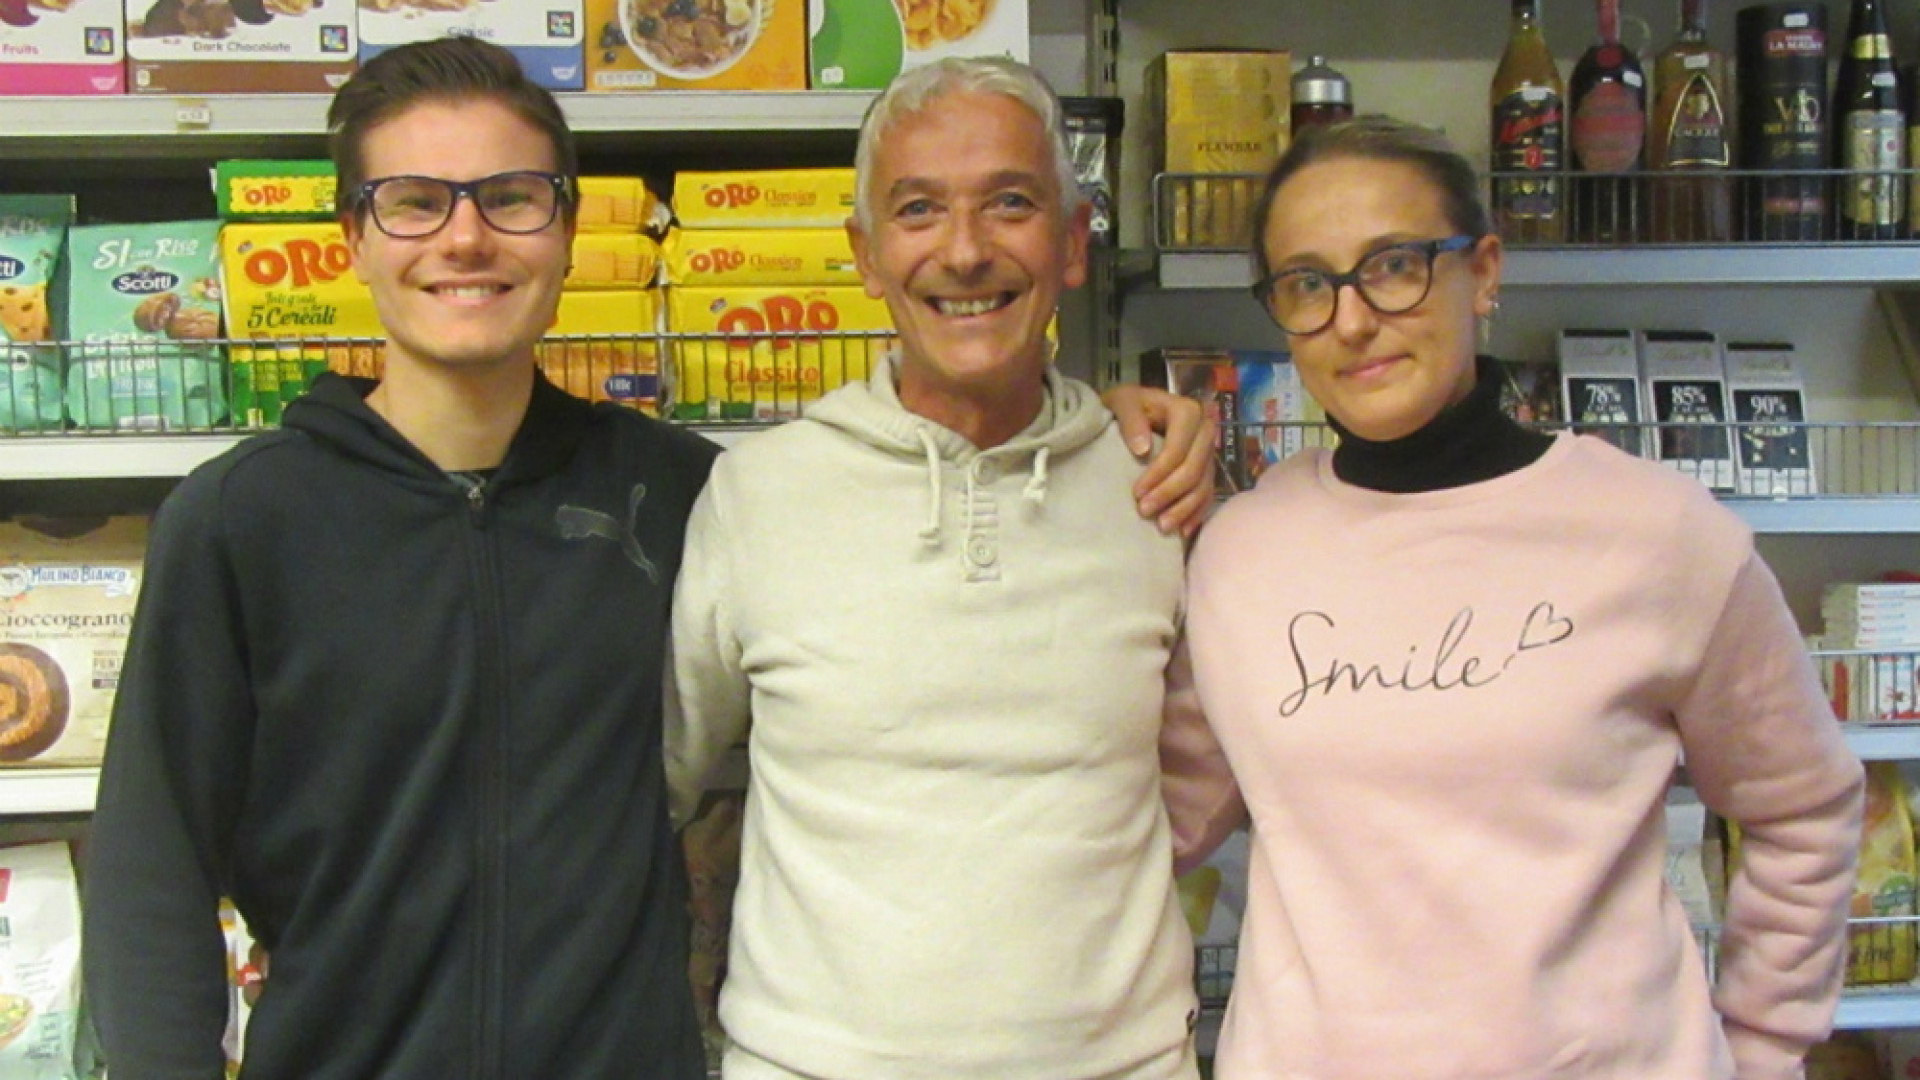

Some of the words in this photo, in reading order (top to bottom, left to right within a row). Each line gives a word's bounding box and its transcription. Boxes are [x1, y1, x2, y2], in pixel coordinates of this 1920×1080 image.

[446, 25, 495, 38] Classic
[2, 43, 39, 55] Fruits
[192, 41, 224, 53] Dark
[226, 41, 291, 53] Chocolate
[245, 184, 291, 206] ORO
[704, 183, 761, 209] ORO
[764, 188, 817, 203] Classico
[243, 238, 352, 289] ORO
[690, 247, 746, 274] ORO
[749, 253, 803, 268] Classico
[118, 275, 172, 291] Scotti
[717, 294, 839, 350] ORO
[723, 360, 821, 383] Classico
[1278, 606, 1501, 718] Smile
